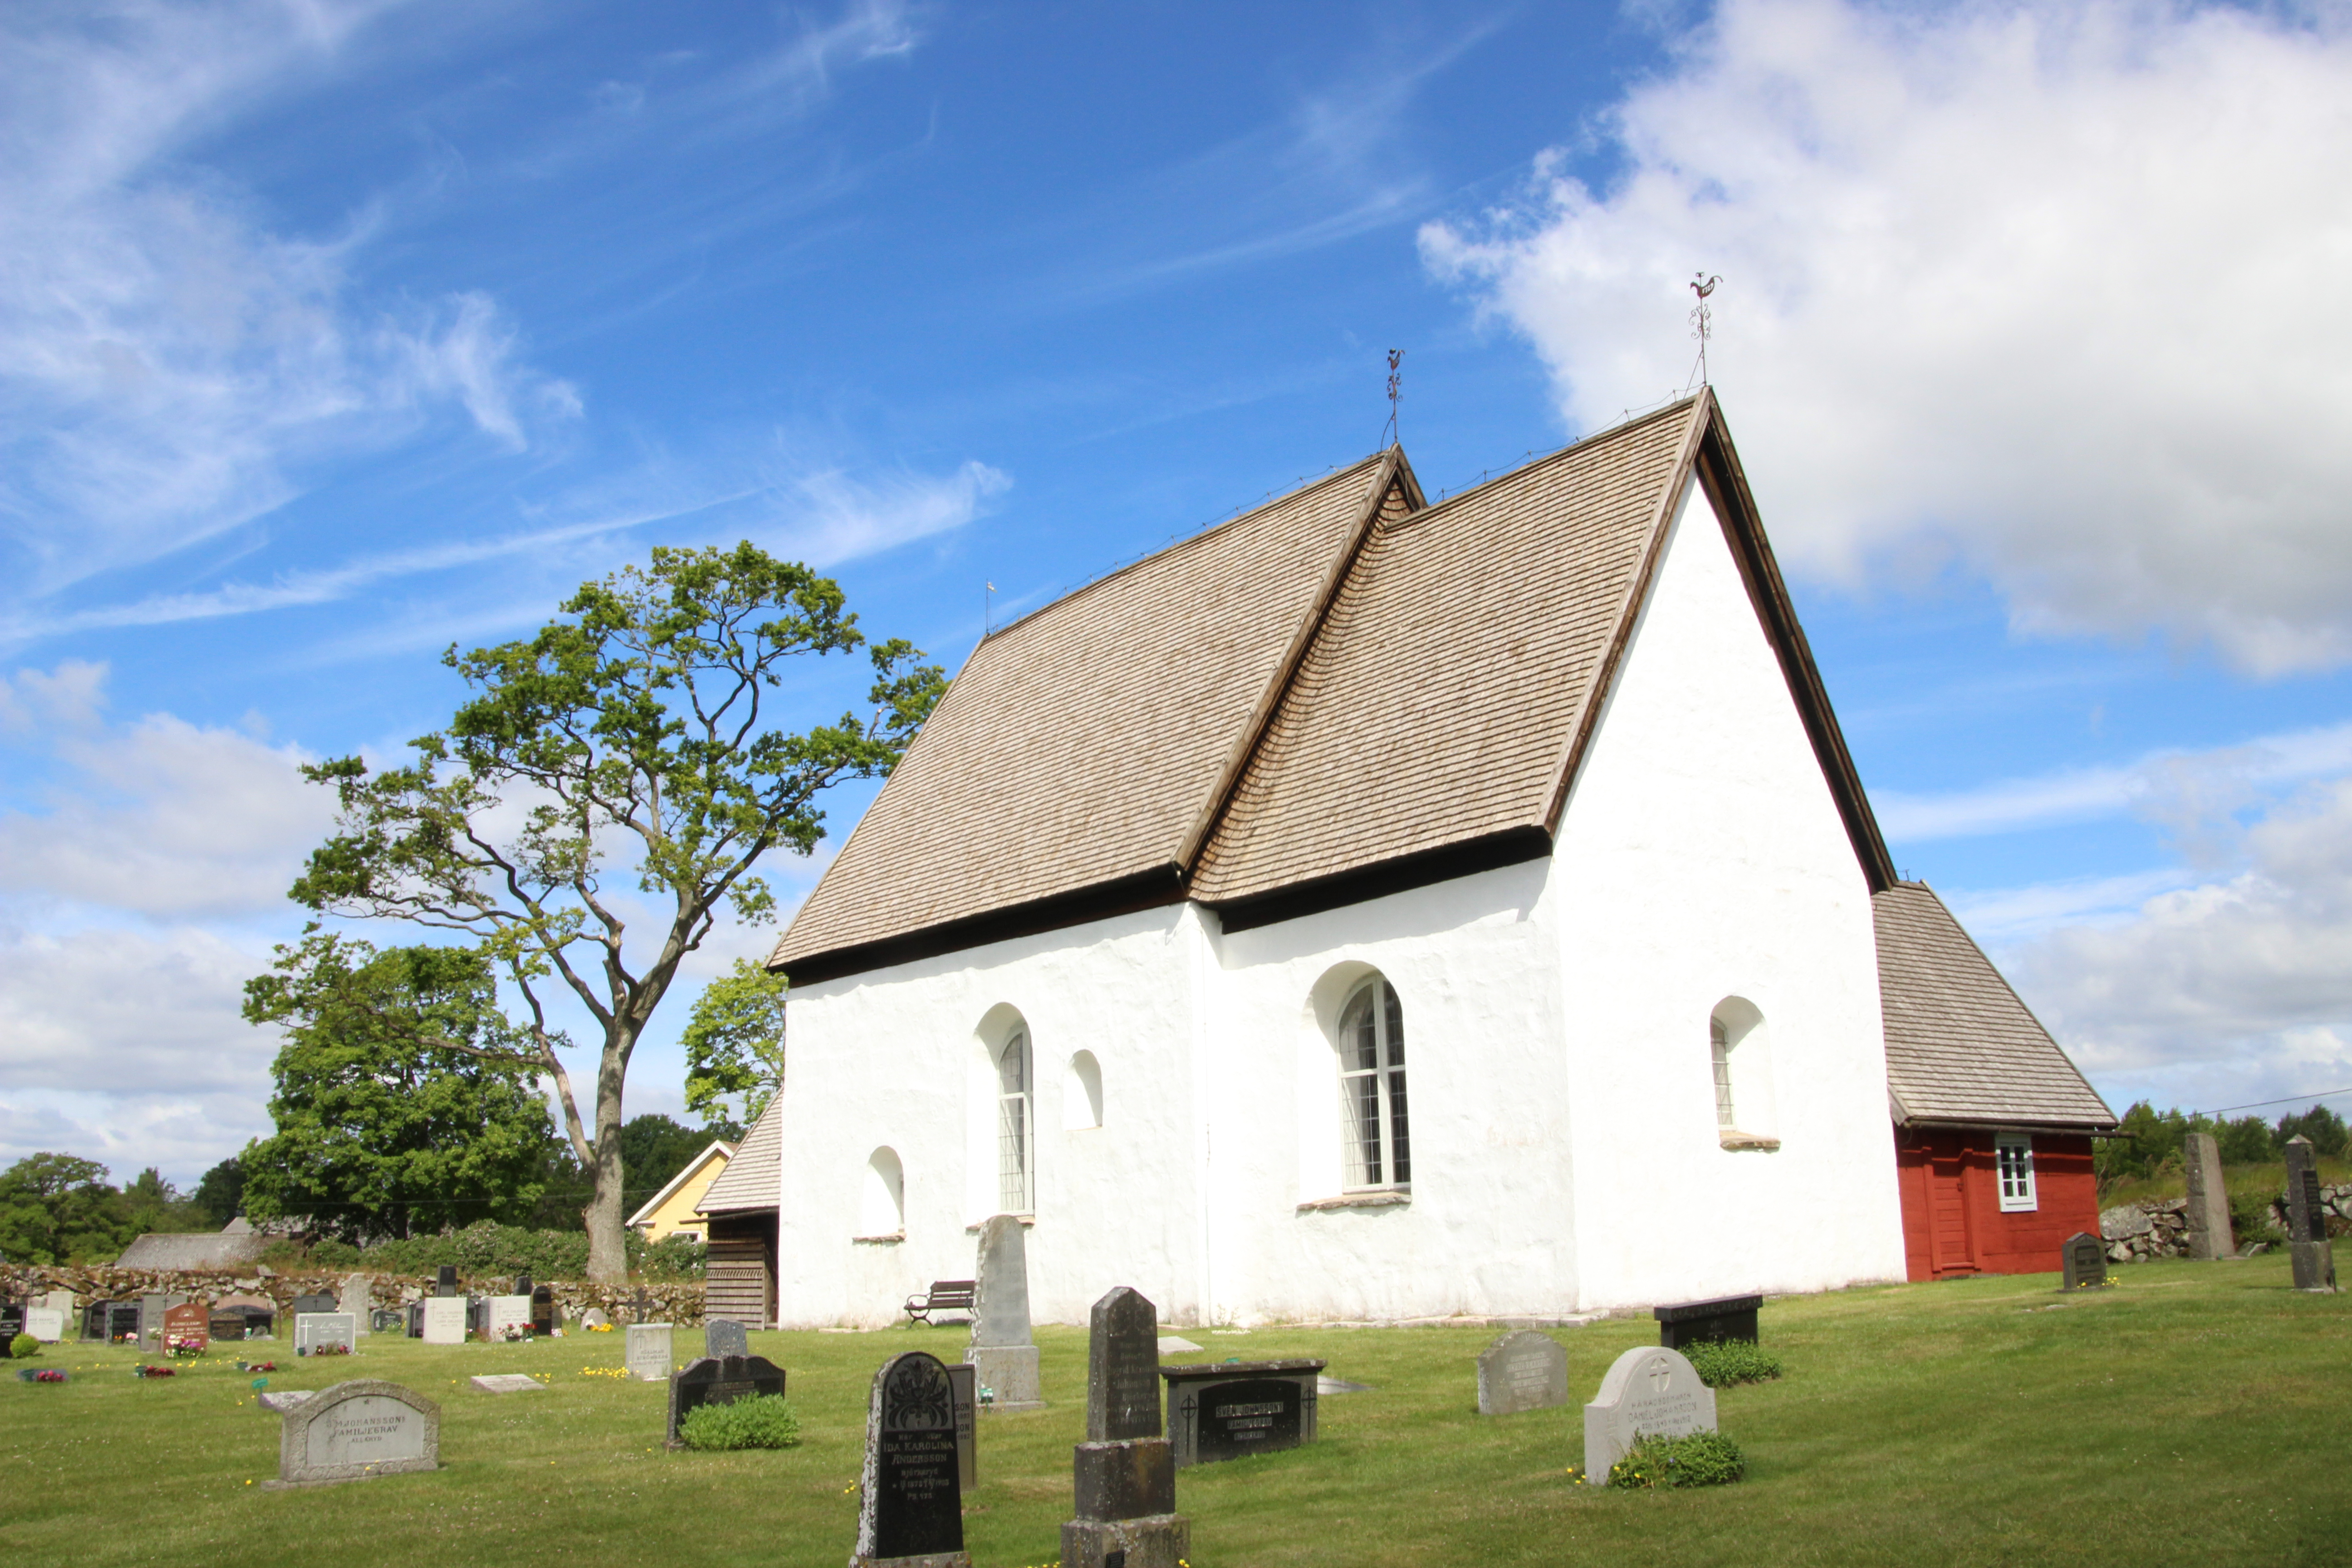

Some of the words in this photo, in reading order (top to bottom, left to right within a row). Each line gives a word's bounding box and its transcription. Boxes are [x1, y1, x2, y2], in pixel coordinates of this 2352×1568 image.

[884, 1442, 900, 1452] IDA
[904, 1441, 954, 1451] KAROLINA
[892, 1454, 947, 1465] ANDERSSON
